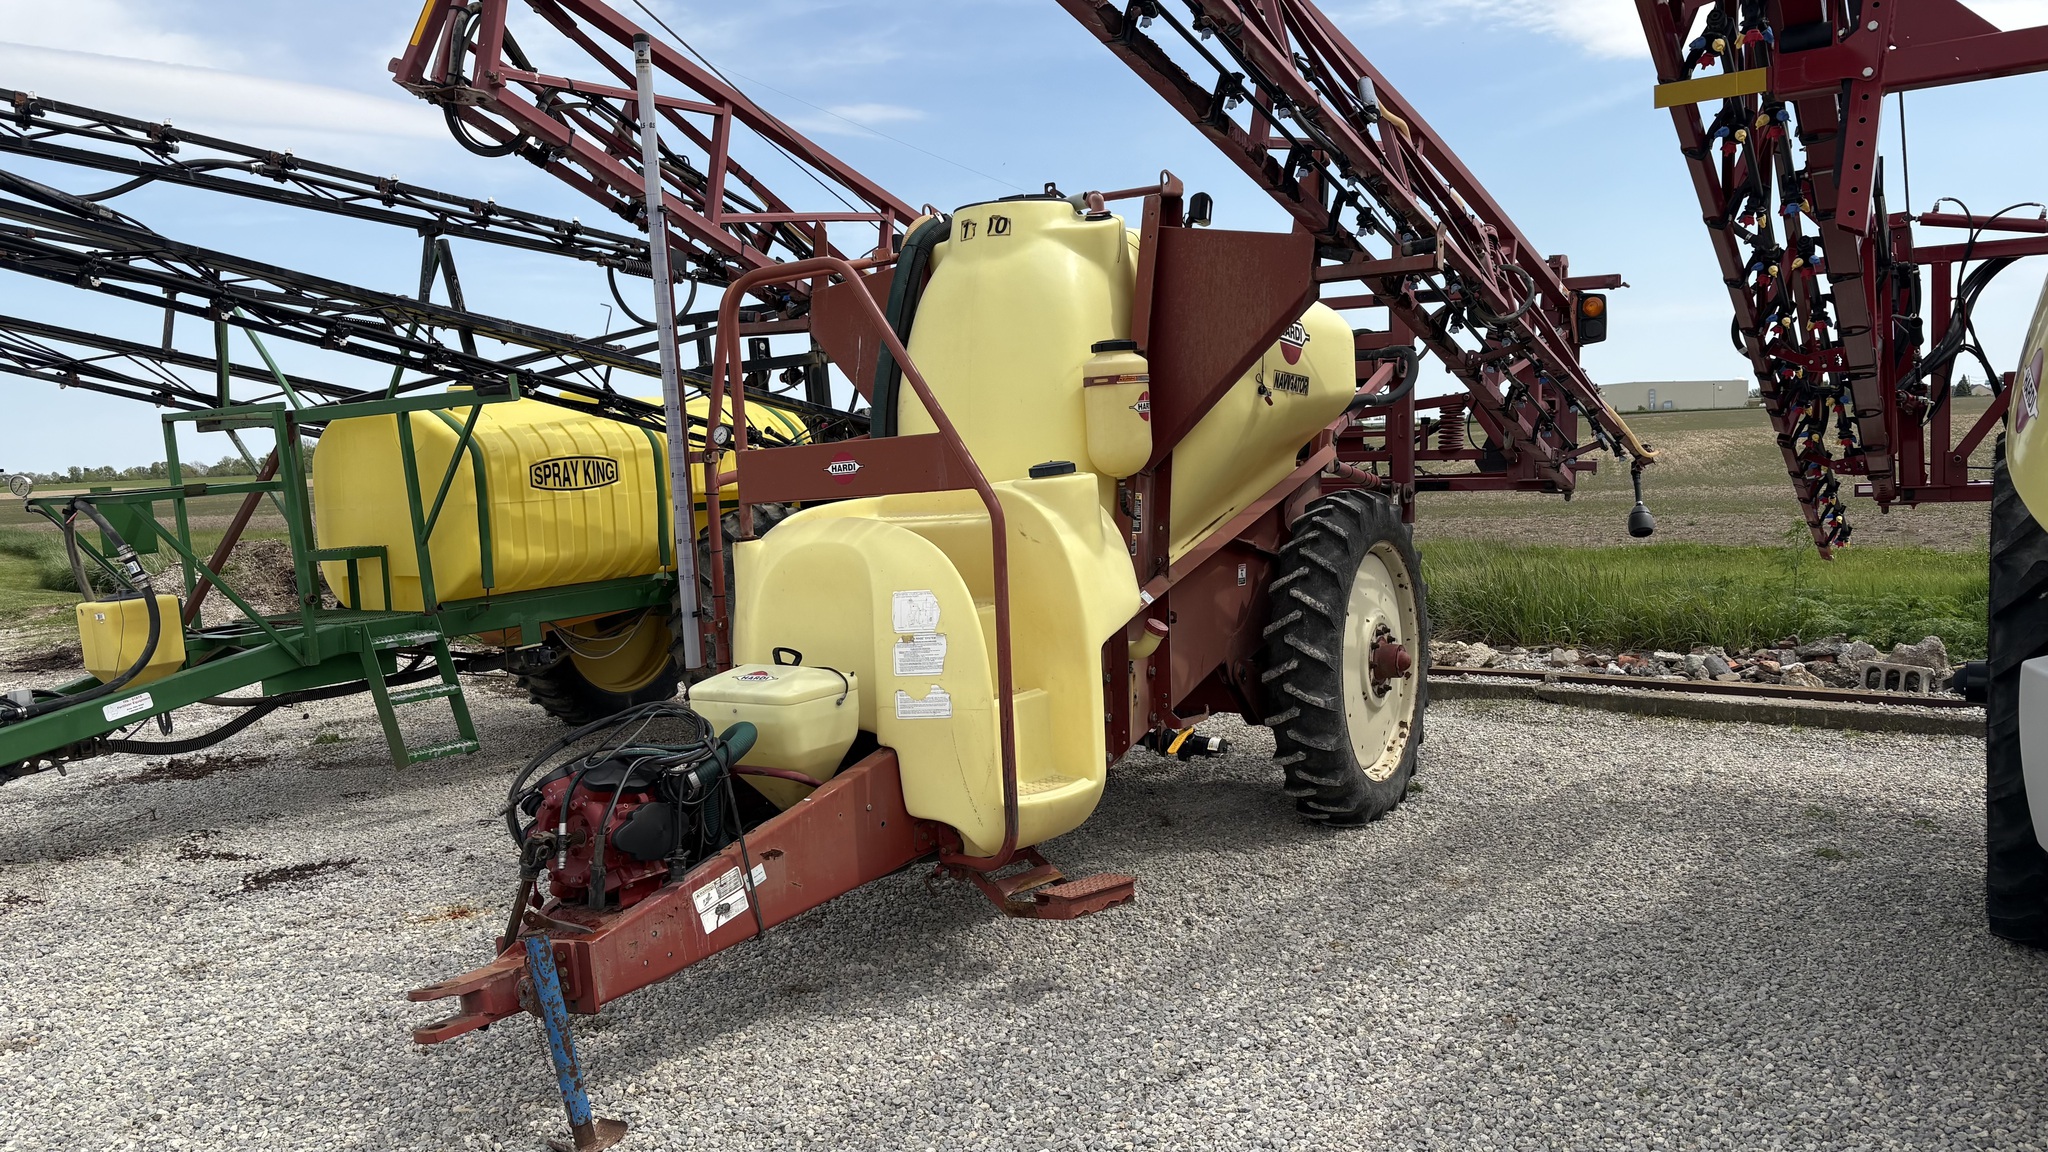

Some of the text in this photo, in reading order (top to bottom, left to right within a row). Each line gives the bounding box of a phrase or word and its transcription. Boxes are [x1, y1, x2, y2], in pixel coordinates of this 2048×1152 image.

[1283, 325, 1303, 343] ARDI
[1274, 372, 1309, 395] NAVIGATOR
[2023, 369, 2037, 413] HARDI
[534, 460, 615, 487] SPRAY KING
[831, 463, 856, 472] HARDI
